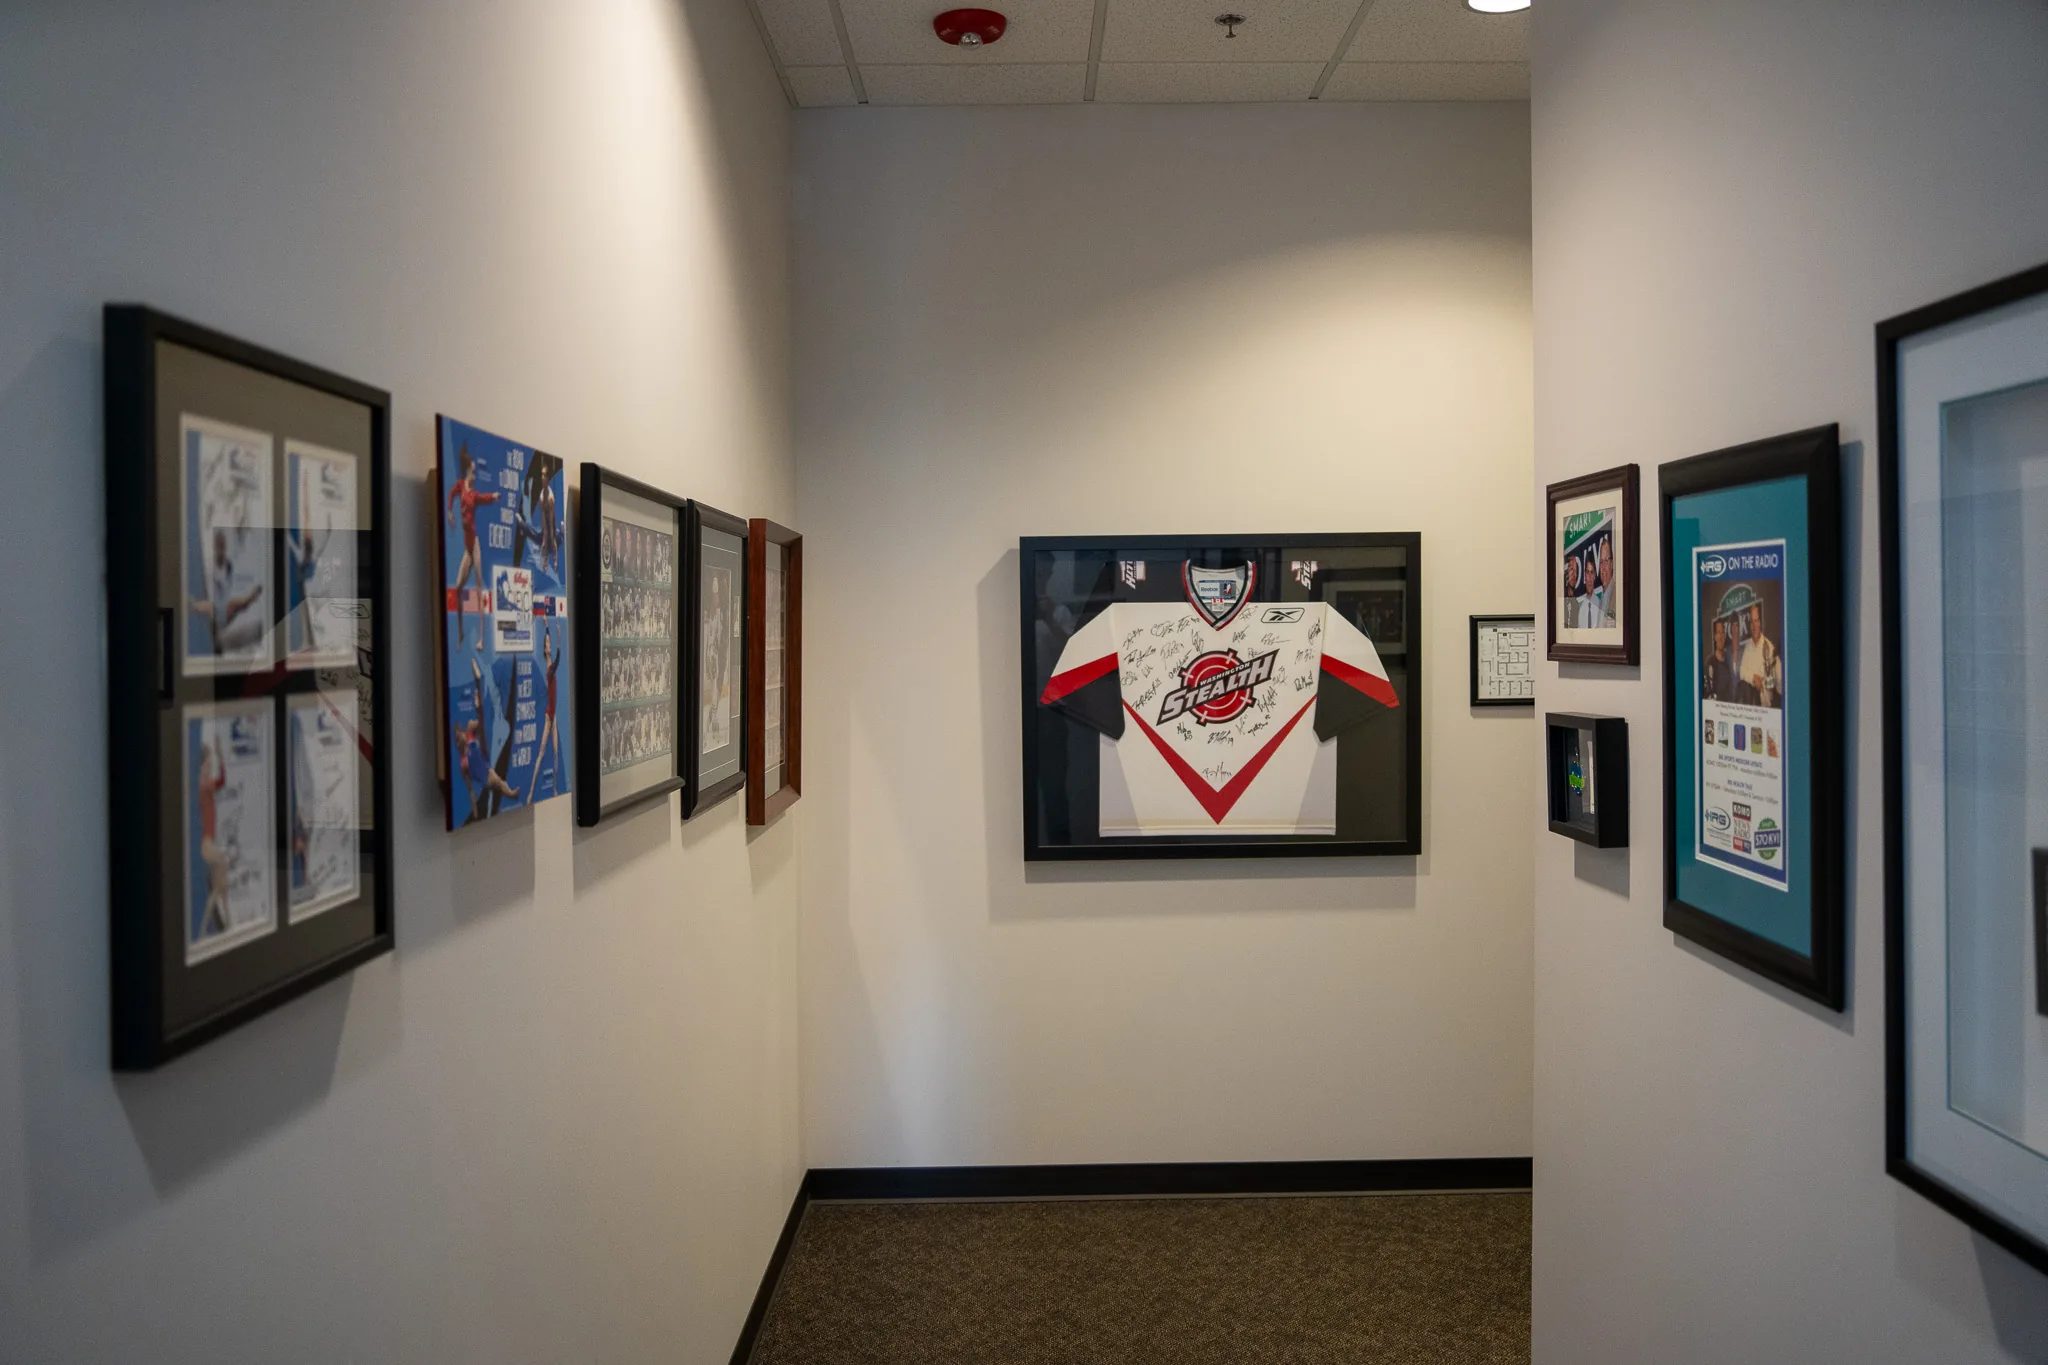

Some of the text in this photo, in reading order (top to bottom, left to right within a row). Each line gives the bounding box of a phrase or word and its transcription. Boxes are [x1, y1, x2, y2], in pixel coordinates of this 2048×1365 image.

[1728, 556, 1740, 570] ON
[1741, 555, 1754, 569] THE
[1755, 553, 1778, 568] RADIO
[1200, 661, 1251, 686] WASHINGTON
[1158, 651, 1278, 724] STEALTH
